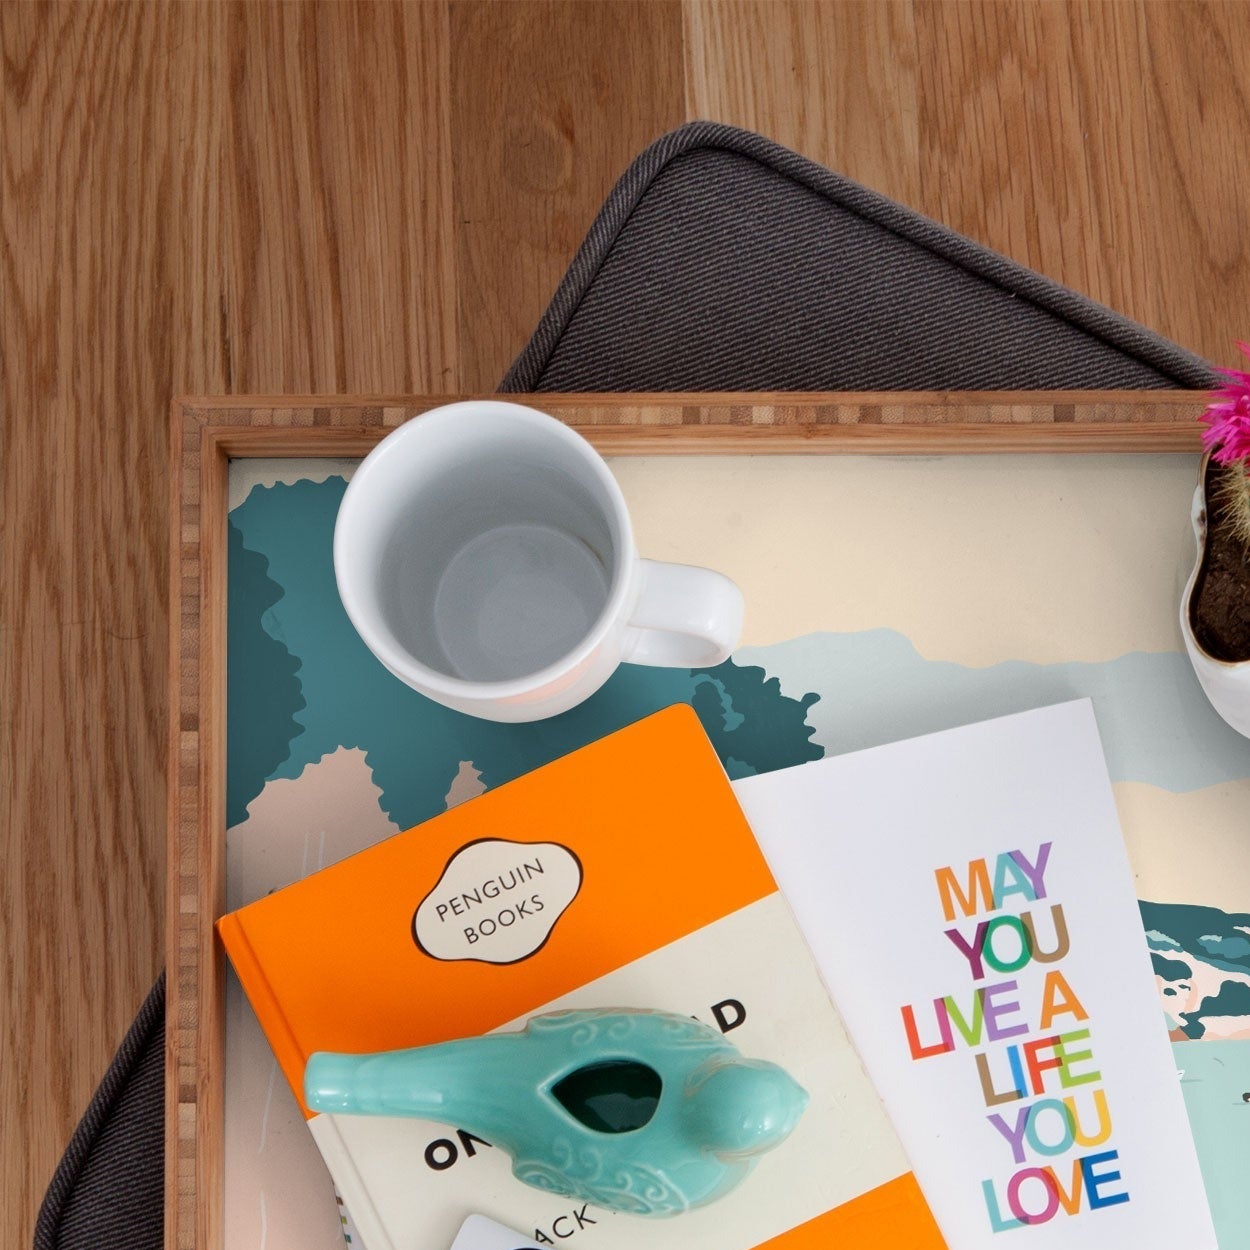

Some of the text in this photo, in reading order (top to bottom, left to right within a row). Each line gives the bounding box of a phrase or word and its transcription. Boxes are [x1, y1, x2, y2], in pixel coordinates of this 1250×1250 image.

[435, 858, 544, 922] PENGUIN
[463, 894, 544, 944] BOOKS
[934, 841, 1053, 922] MAY
[944, 903, 1071, 981] YOU
[900, 970, 1090, 1061] LIVE A
[974, 1028, 1102, 1107] LIFE
[986, 1089, 1112, 1165] YOU
[535, 1203, 598, 1245] ACK
[981, 1149, 1130, 1234] LOVE
